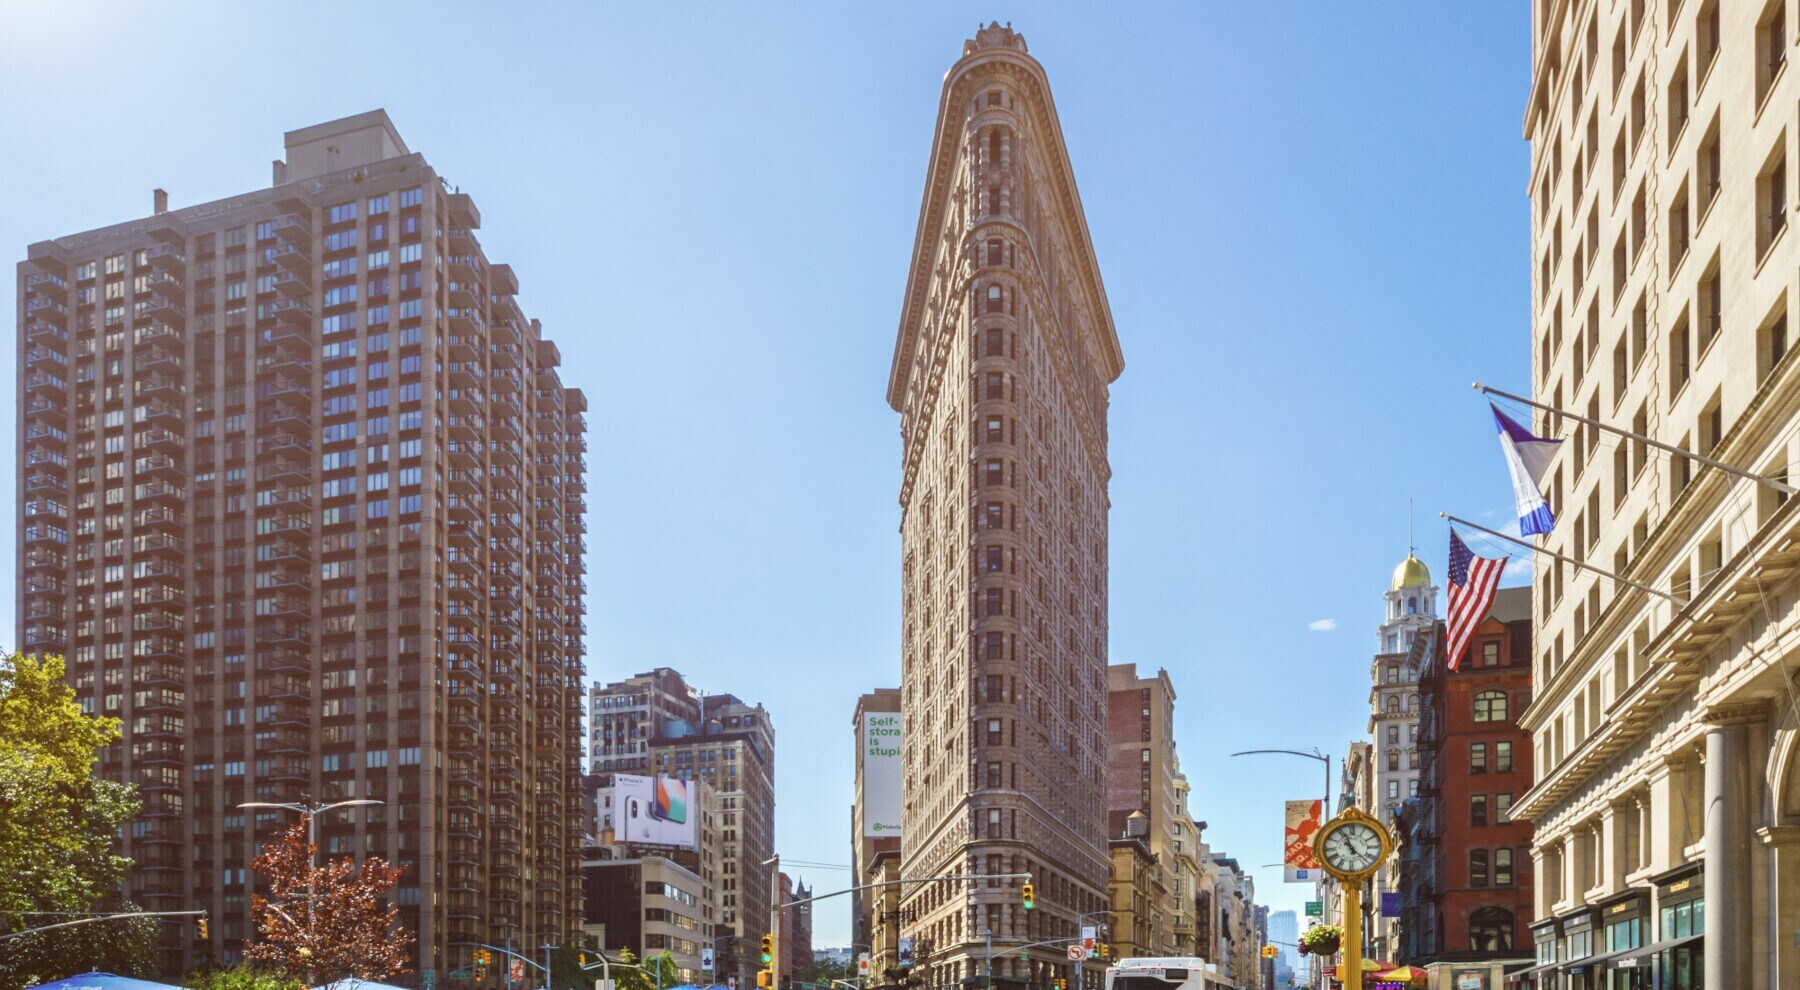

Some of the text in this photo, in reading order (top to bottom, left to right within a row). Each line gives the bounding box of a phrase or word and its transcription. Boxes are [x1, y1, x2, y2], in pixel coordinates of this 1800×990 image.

[869, 717, 898, 726] Self-
[869, 737, 879, 745] is
[869, 746, 902, 757] stupi
